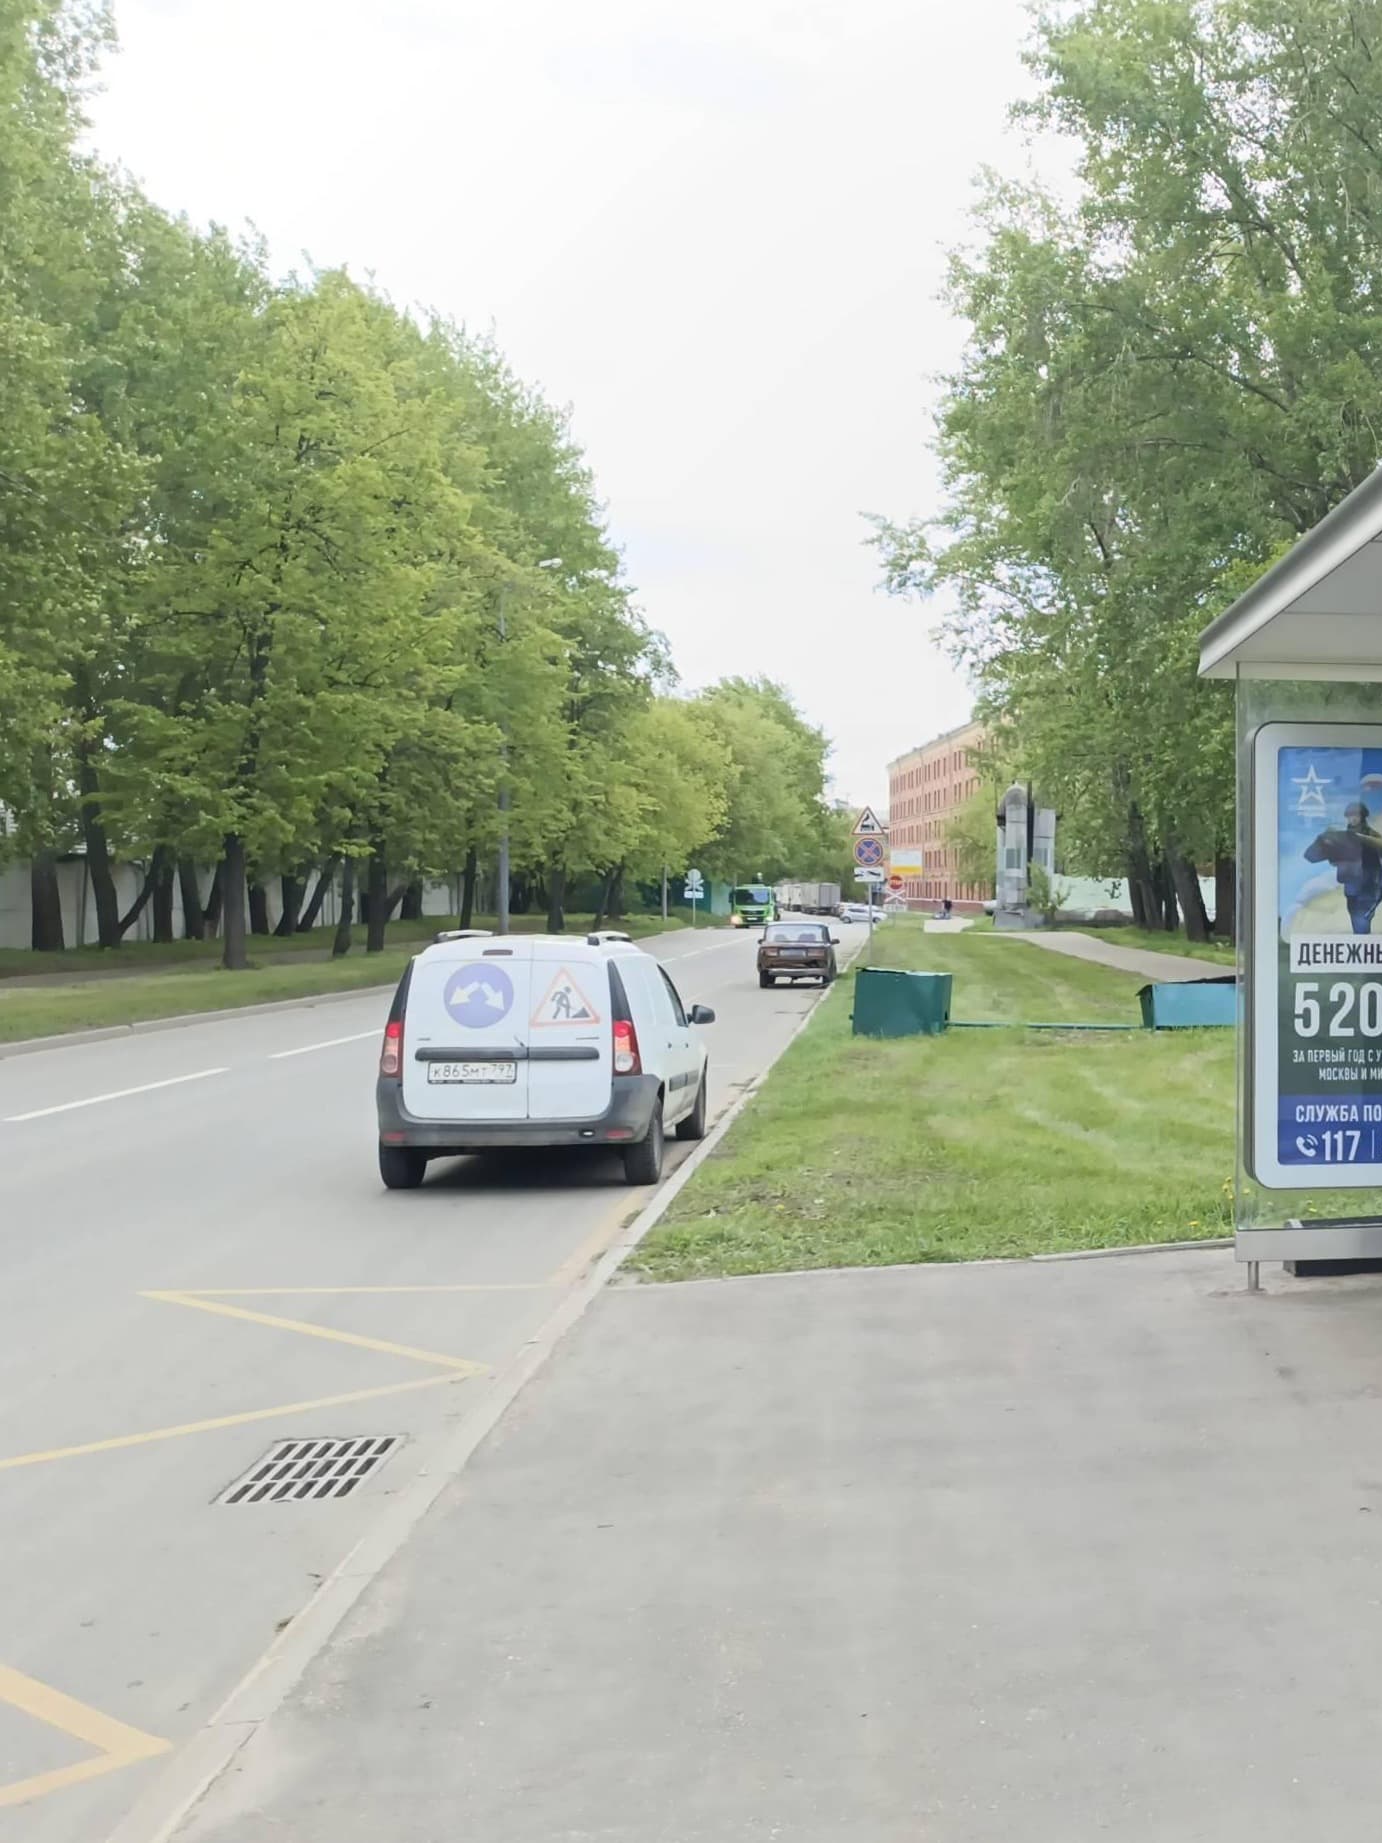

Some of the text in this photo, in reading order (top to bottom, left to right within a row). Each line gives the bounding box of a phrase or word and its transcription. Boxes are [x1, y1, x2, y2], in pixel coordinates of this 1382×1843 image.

[1293, 1050, 1304, 1063] ЗА
[1307, 1048, 1345, 1063] ПЕРВЫЙ
[1348, 1049, 1365, 1064] ГОД
[1368, 1049, 1374, 1063] С
[1319, 1067, 1358, 1081] МОСКВЫ
[1361, 1067, 1367, 1080] И
[1295, 1104, 1359, 1123] СЛУЖБА
[1363, 1104, 1382, 1122] ПО
[1321, 1130, 1361, 1161] 117
